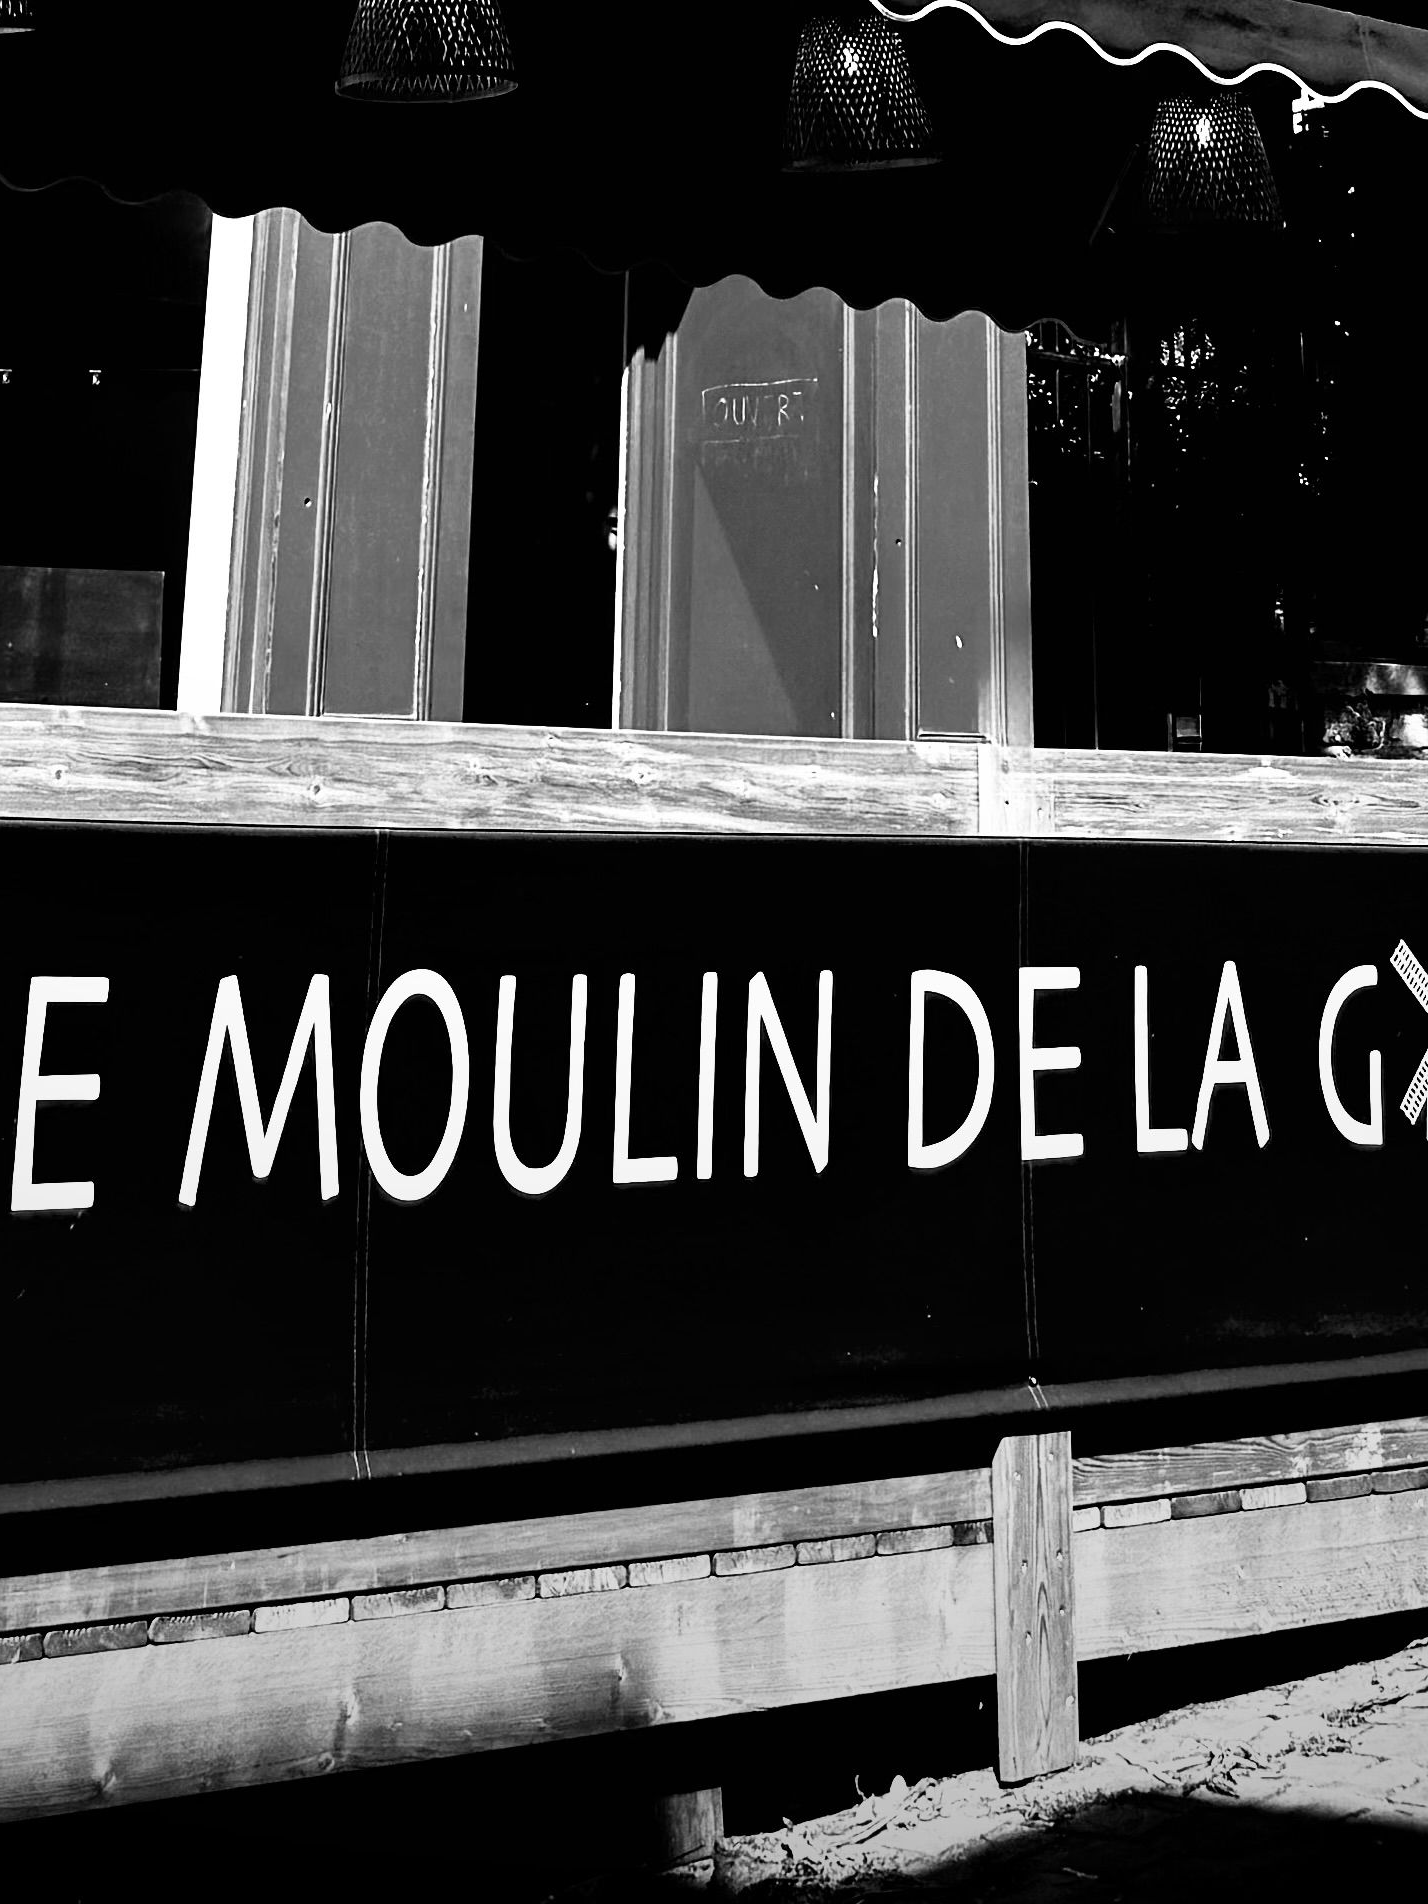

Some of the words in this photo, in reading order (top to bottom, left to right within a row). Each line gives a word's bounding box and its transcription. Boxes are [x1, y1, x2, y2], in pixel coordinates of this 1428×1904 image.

[713, 391, 805, 429] OUVR
[178, 968, 834, 1207] MOULIN
[907, 966, 1085, 1169] DE
[1134, 960, 1270, 1153] LA
